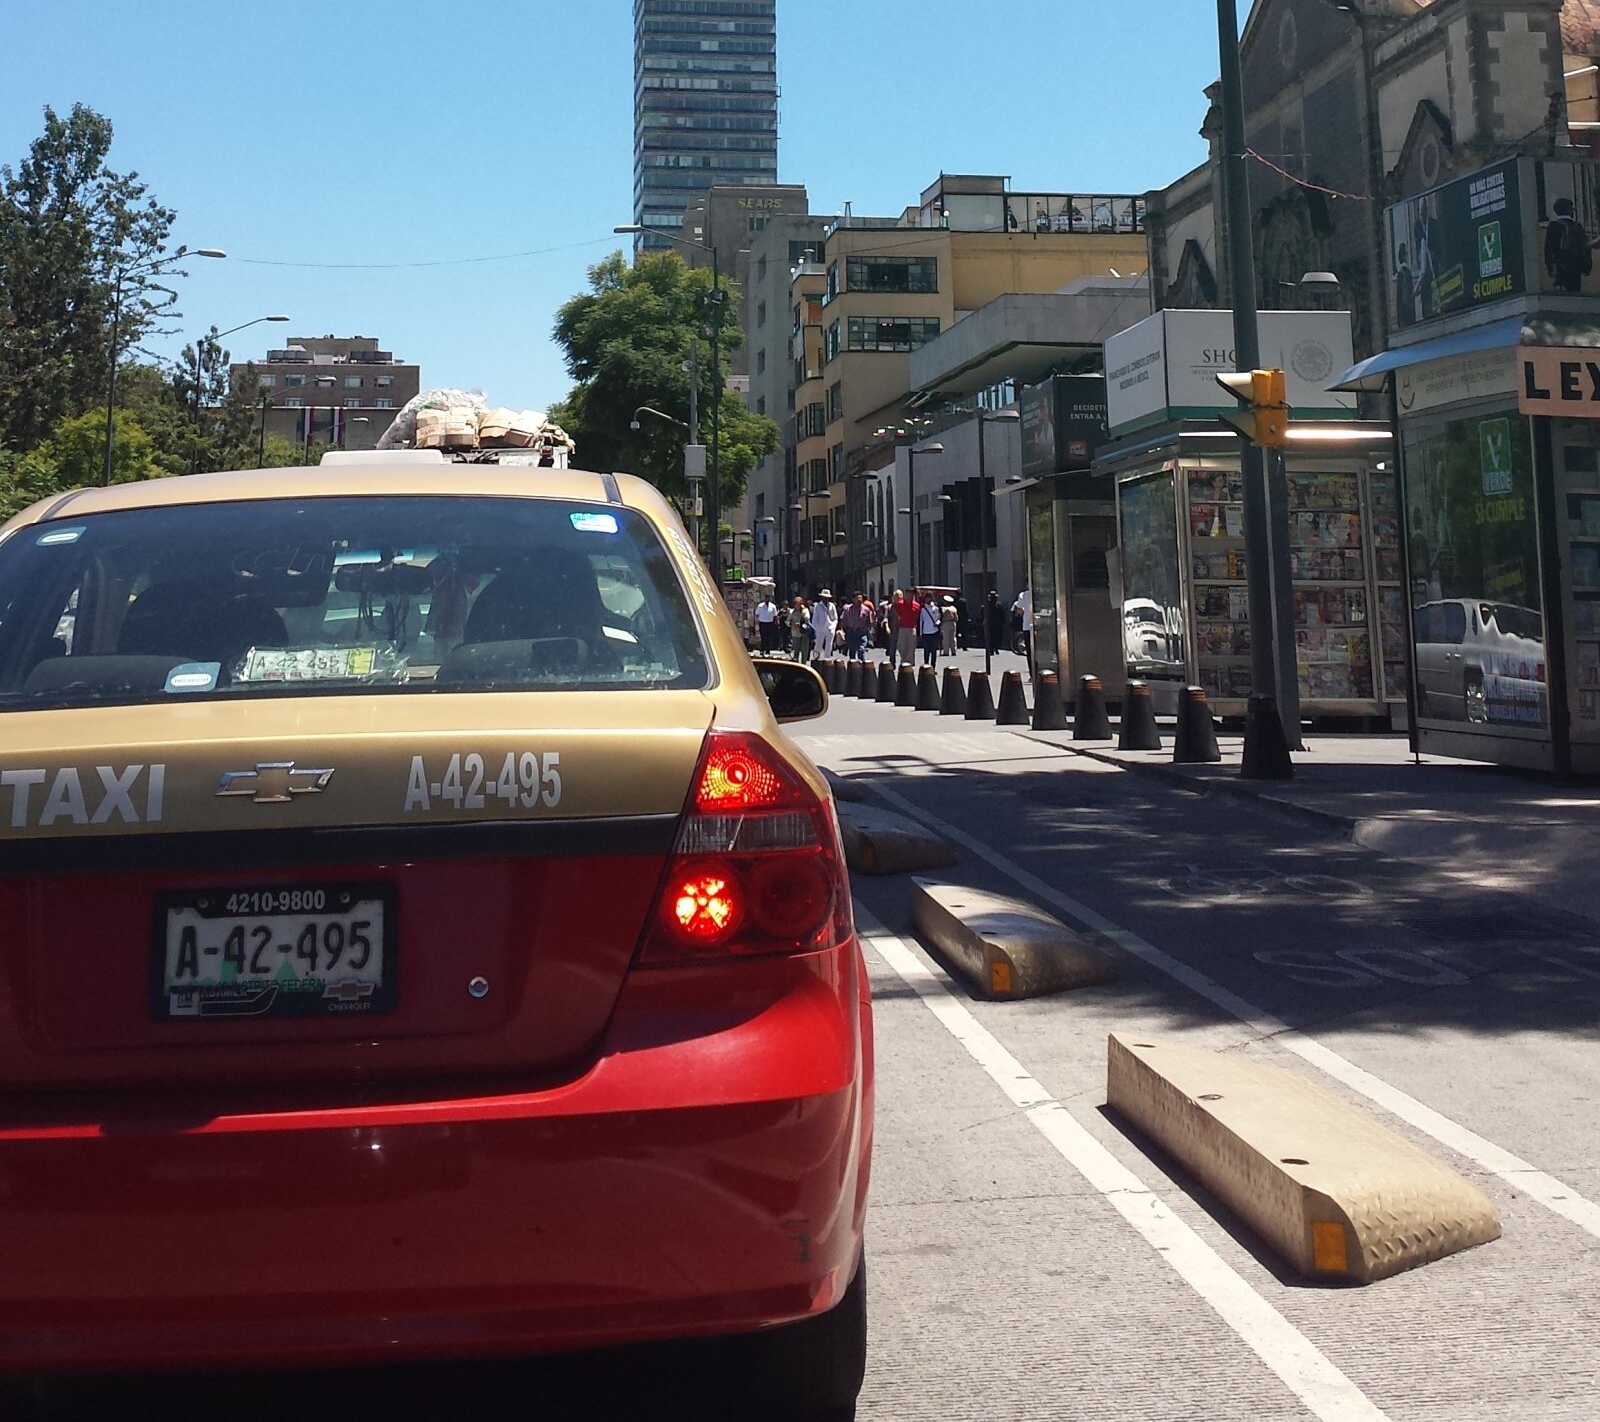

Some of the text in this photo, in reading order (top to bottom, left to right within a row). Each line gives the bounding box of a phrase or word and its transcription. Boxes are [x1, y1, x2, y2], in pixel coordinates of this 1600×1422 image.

[737, 197, 783, 209] SEARS
[1481, 274, 1513, 296] CUMPLE
[1484, 469, 1512, 491] VERDE
[1486, 498, 1526, 523] CUMPLE
[404, 752, 562, 810] A-42-495
[0, 764, 165, 826] TAXI
[226, 889, 325, 913] 4210-9800
[176, 921, 371, 978] A-42-495
[328, 1001, 372, 1011] CHEVROLET
